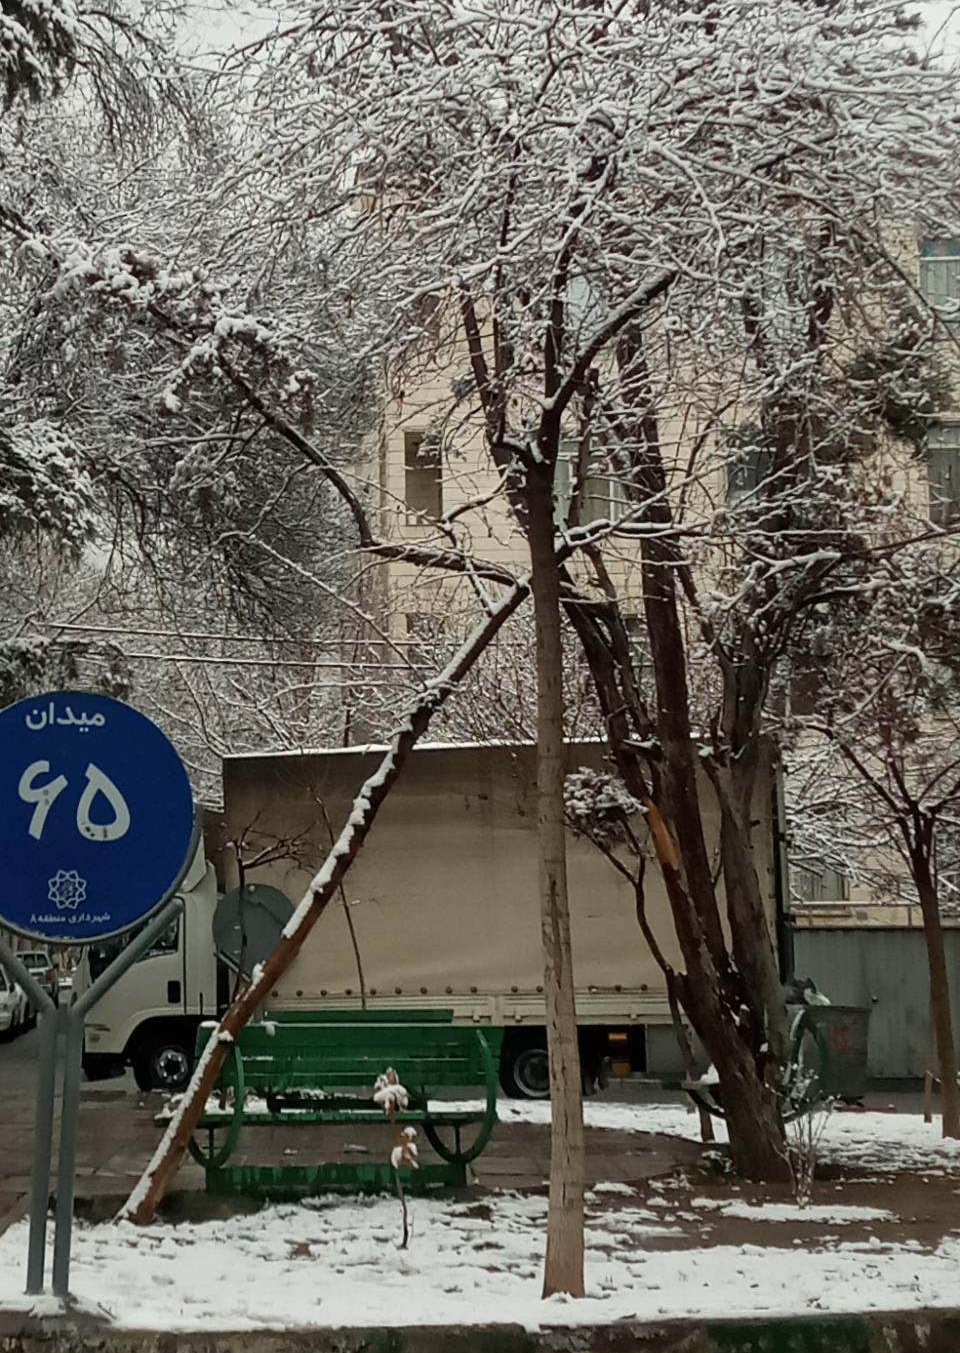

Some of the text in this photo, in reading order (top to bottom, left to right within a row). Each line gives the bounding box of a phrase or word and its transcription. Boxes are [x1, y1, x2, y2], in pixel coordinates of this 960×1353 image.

[25, 702, 106, 732] میدان
[18, 759, 131, 842] ۶۵
[68, 912, 111, 924] شهرداری
